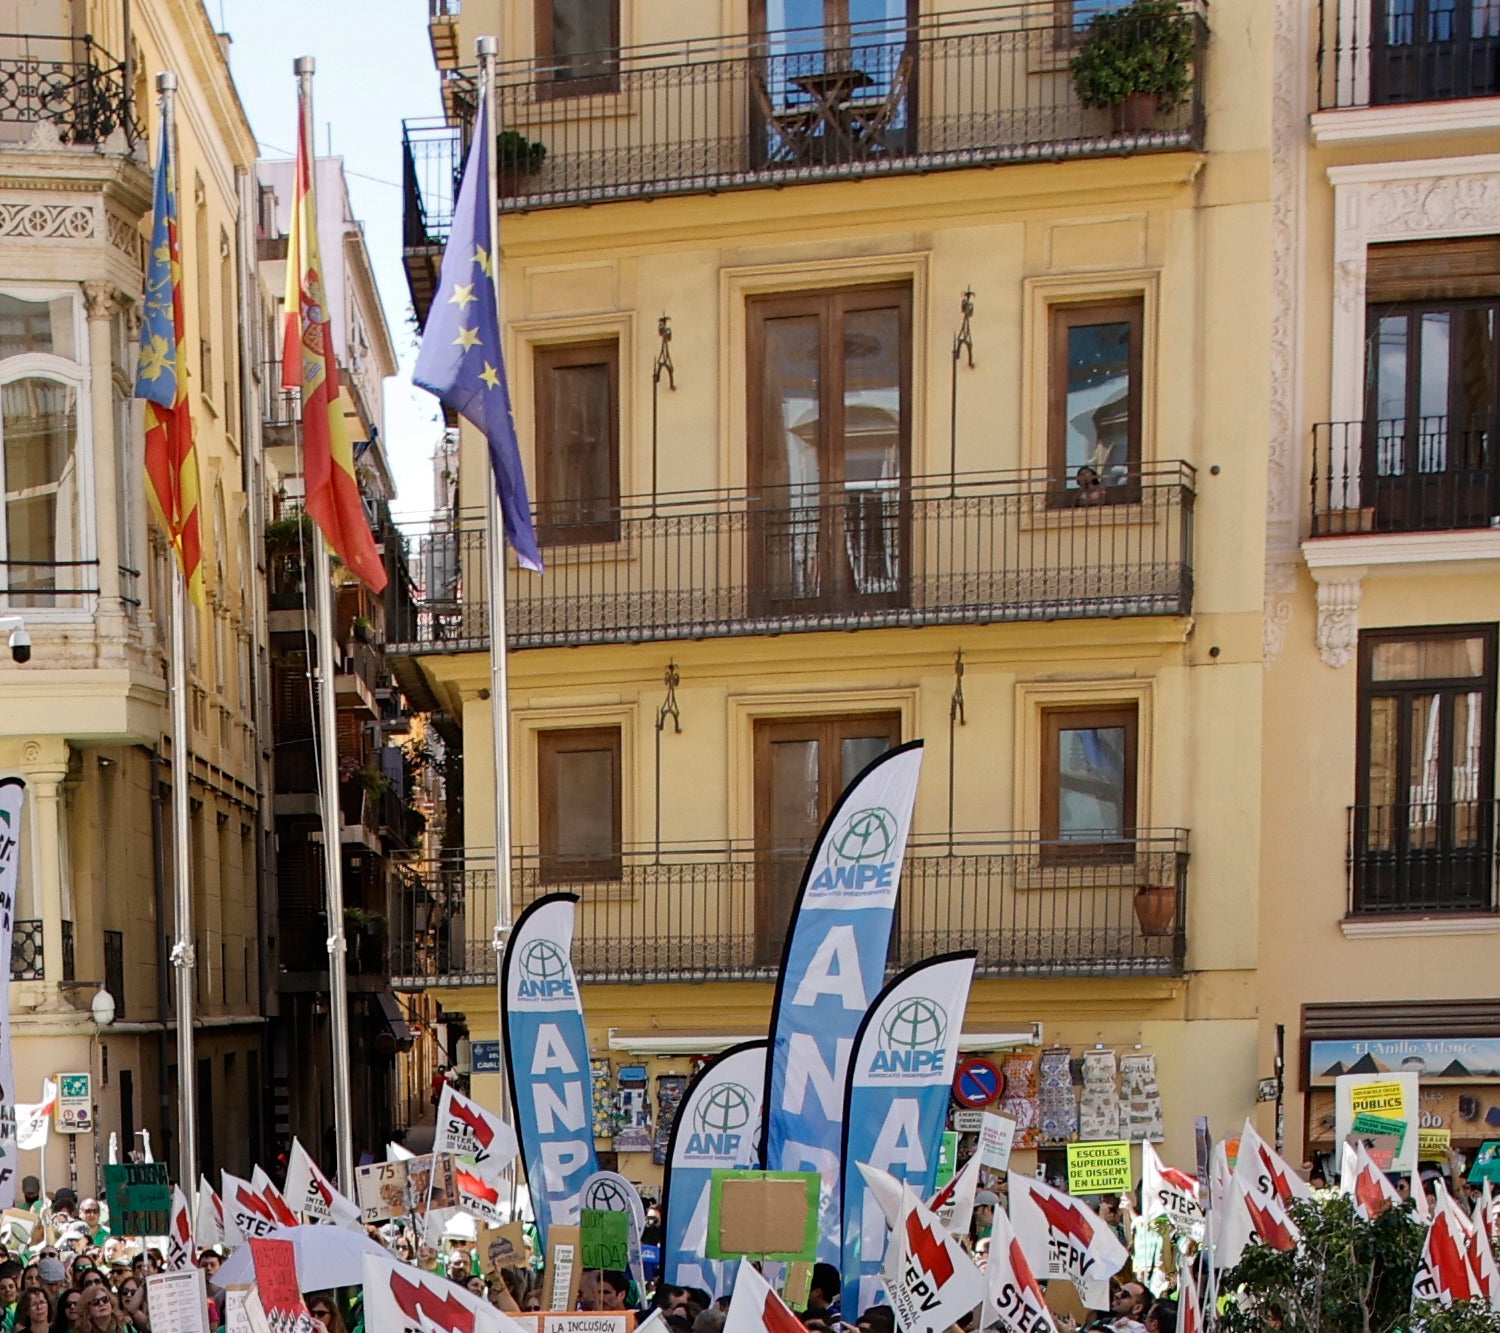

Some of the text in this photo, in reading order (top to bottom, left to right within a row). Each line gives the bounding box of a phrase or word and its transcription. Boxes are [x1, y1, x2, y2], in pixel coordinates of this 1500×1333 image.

[811, 862, 895, 891] ANPE
[518, 979, 574, 997] ANPE
[869, 1050, 945, 1073] ANPE
[684, 1133, 740, 1155] ANP
[1077, 1149, 1120, 1157] ESCOLES
[1071, 1158, 1126, 1168] SUPERIORS
[376, 1165, 395, 1180] 75
[1071, 1167, 1128, 1178] DE DISSENY
[1075, 1177, 1124, 1188] EN LLUITA
[366, 1207, 378, 1218] 75
[552, 1320, 615, 1333] LA INCLUSIÓN
